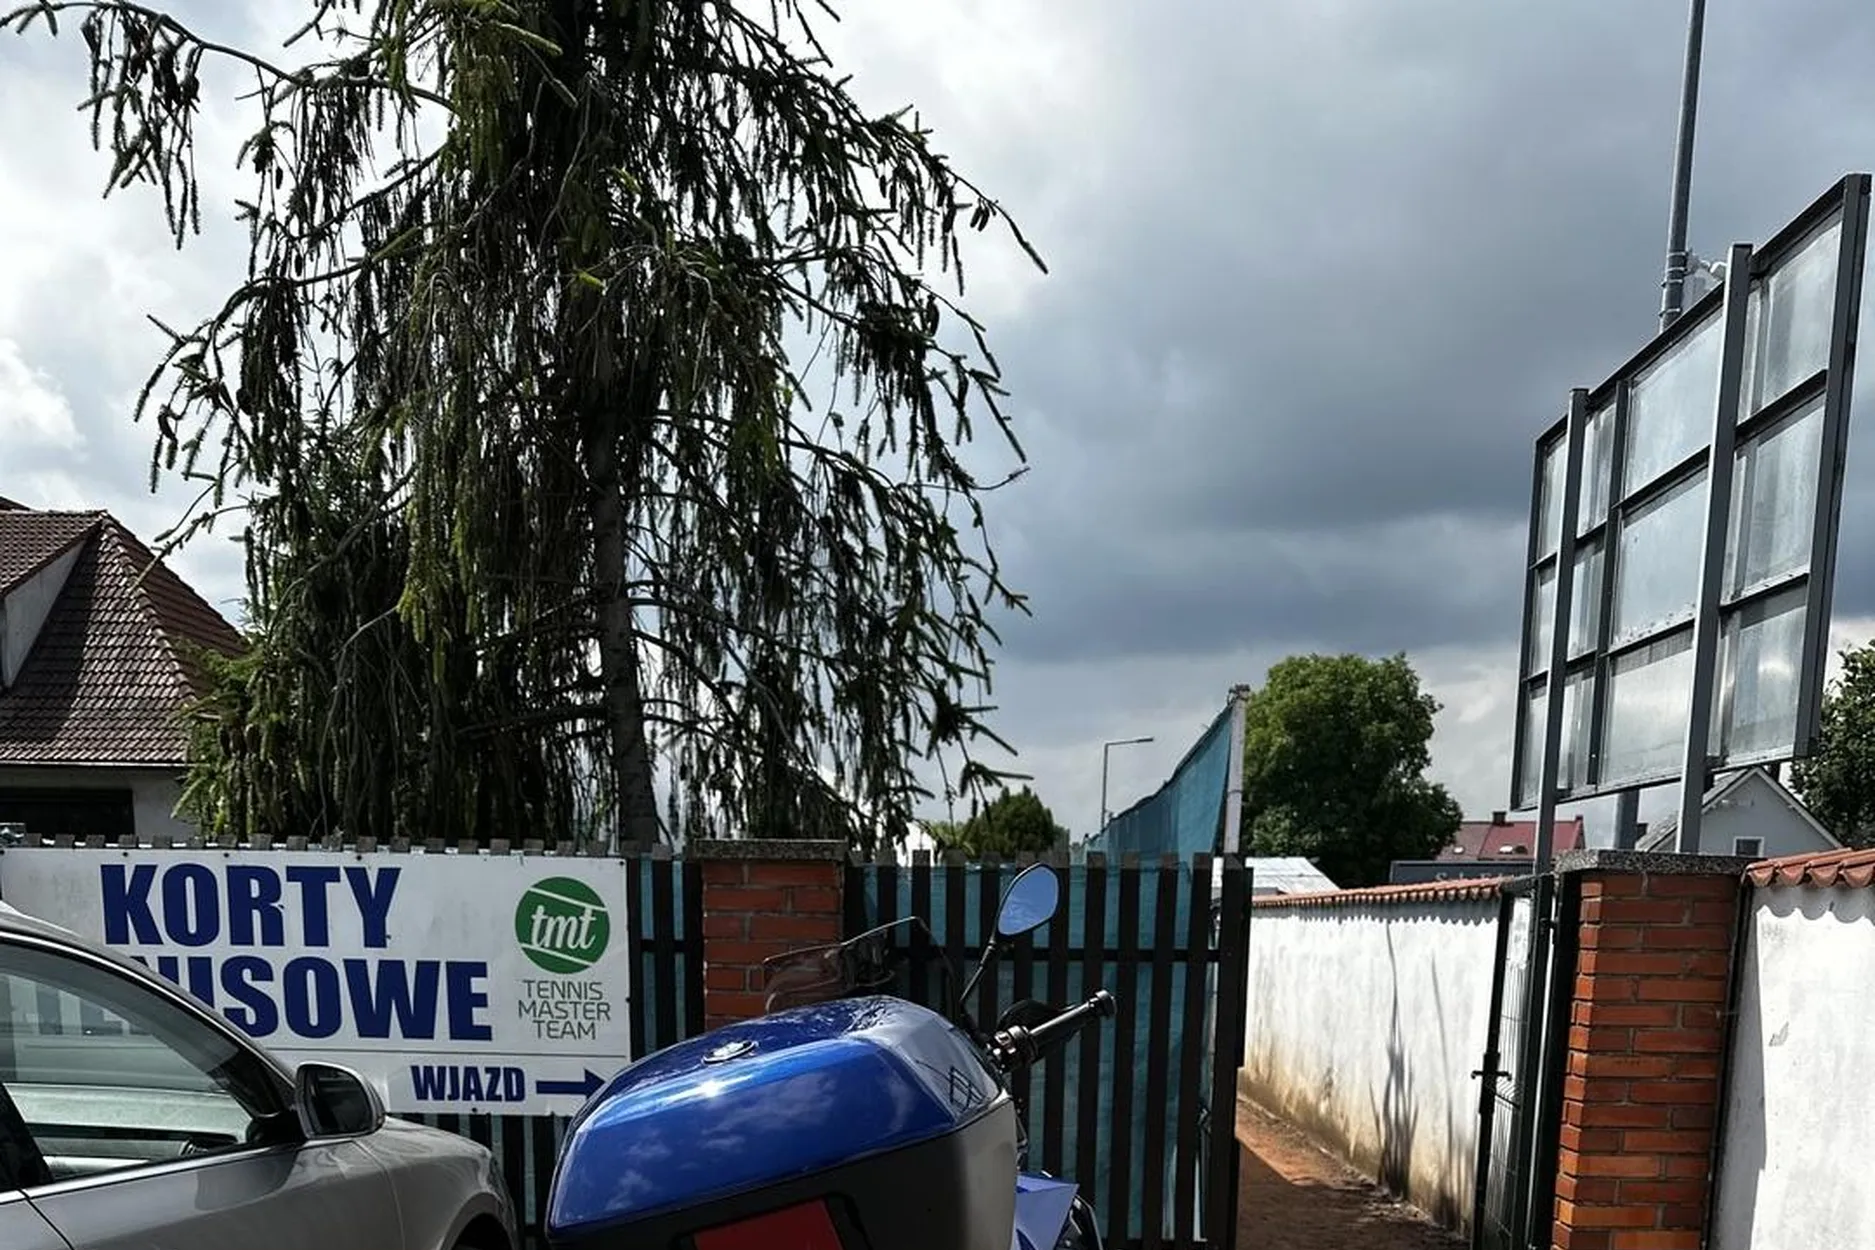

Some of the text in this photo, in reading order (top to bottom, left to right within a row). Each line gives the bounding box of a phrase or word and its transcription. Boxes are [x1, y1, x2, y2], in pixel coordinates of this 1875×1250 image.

[100, 863, 402, 950] KORTY
[531, 904, 597, 950] tmt
[523, 979, 603, 1001] TENNIS
[517, 999, 611, 1021] MASTER
[532, 1019, 596, 1040] TEAM
[410, 1065, 526, 1102] WJAZD
